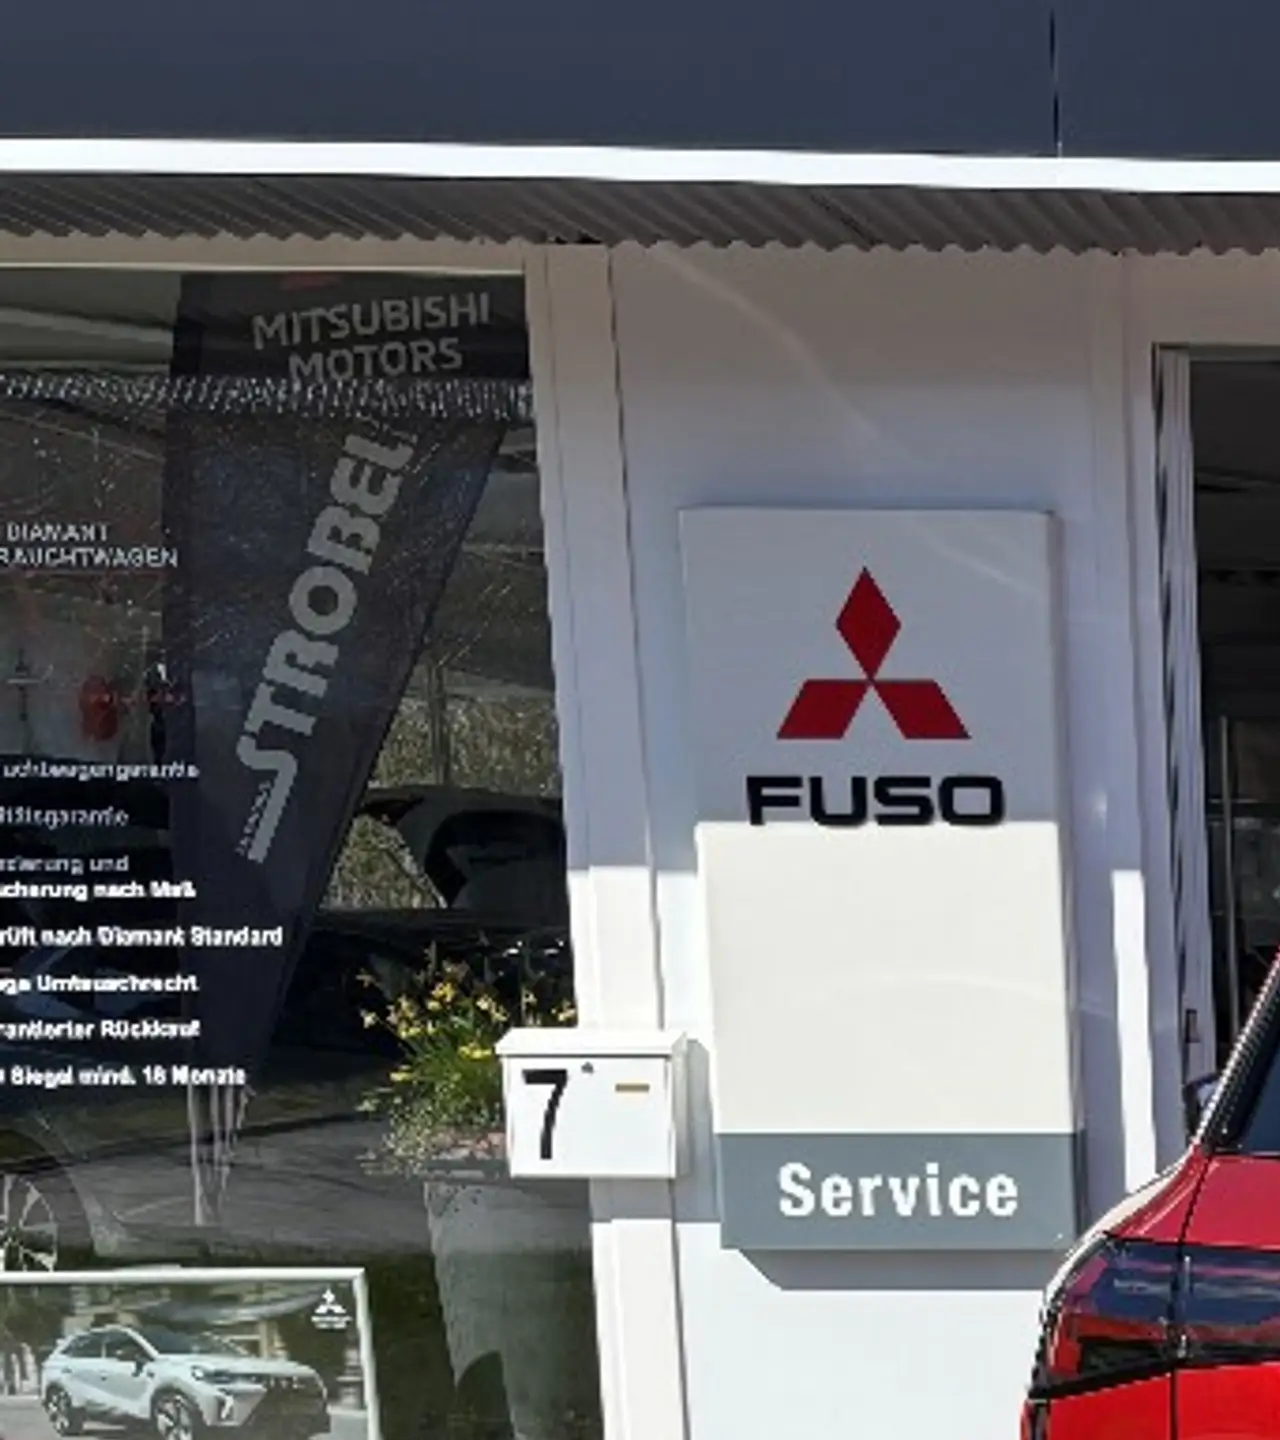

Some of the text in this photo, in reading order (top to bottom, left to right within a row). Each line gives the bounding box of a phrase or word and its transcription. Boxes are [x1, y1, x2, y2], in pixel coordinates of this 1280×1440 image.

[252, 291, 492, 350] MITSUBISHI
[287, 336, 464, 388] MOTORS
[6, 522, 109, 542] DIAMANT
[235, 430, 418, 864] STROBEL
[744, 774, 1007, 827] FUSO
[41, 927, 92, 946] nach
[97, 926, 185, 947] Diamant
[190, 926, 283, 947] Standard
[520, 1067, 569, 1161] 7
[778, 1162, 1019, 1218] Service
